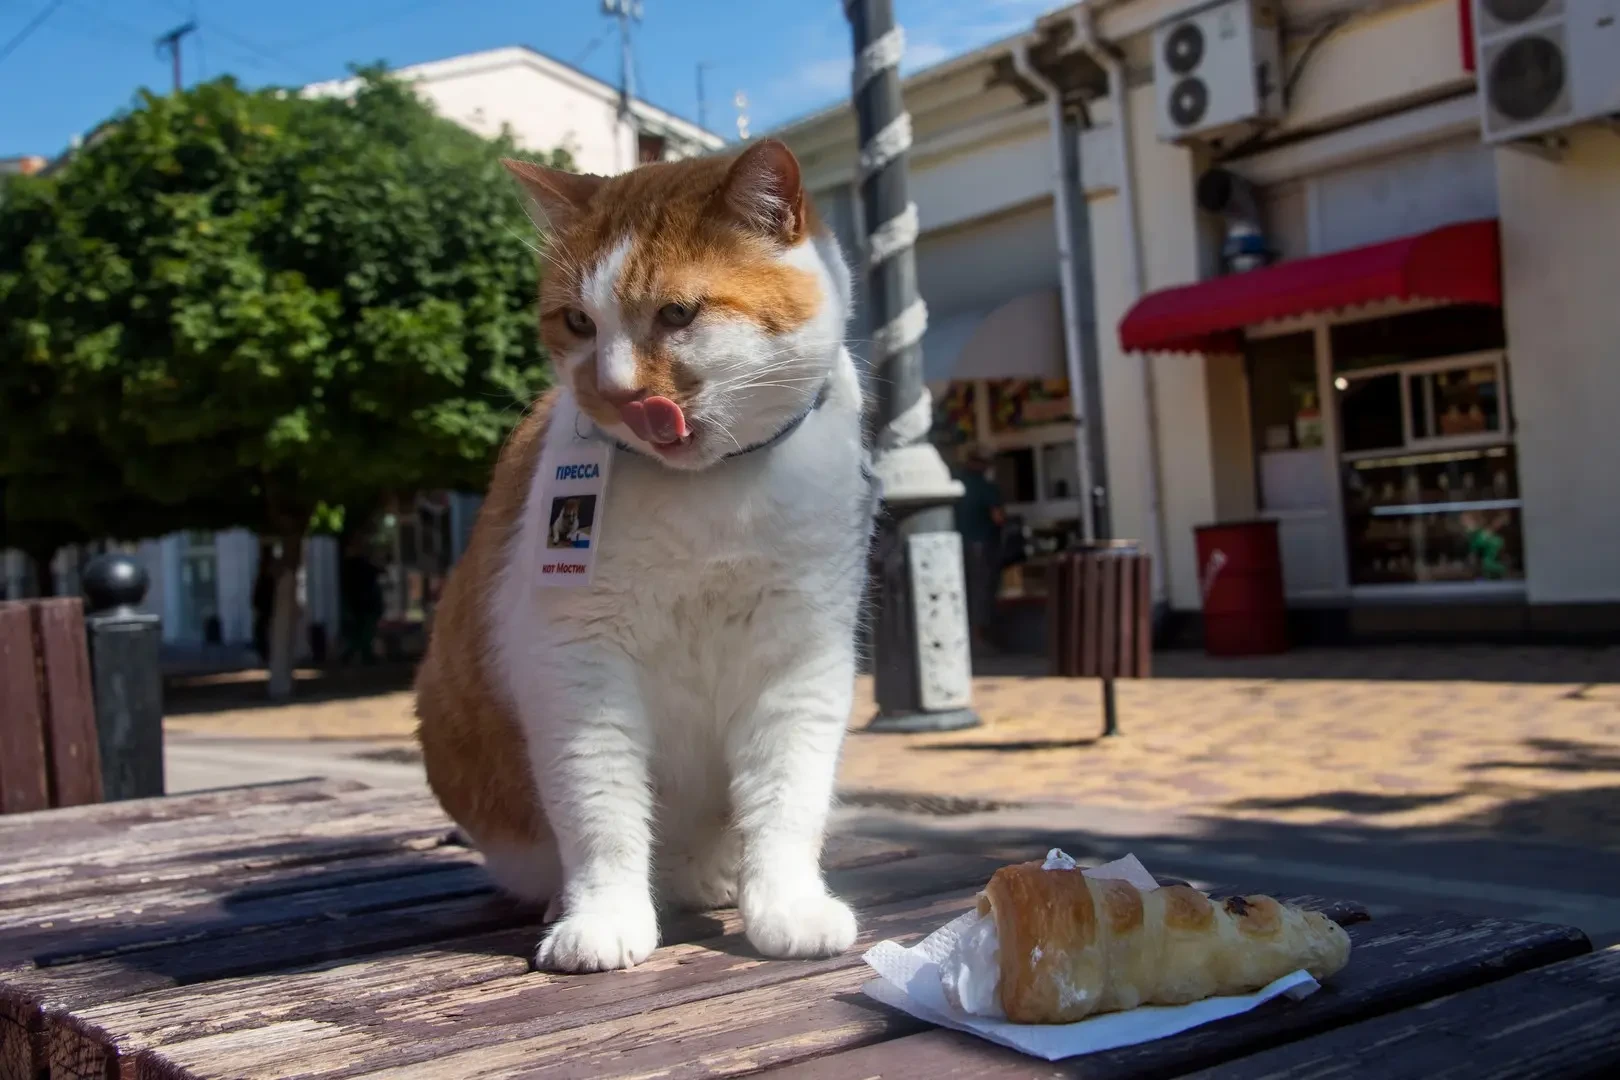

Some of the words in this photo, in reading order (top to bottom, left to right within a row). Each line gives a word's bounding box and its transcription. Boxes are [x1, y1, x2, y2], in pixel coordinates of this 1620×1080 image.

[556, 463, 600, 480] ПРЕССА
[542, 564, 555, 574] кот
[556, 562, 586, 574] Мостик
